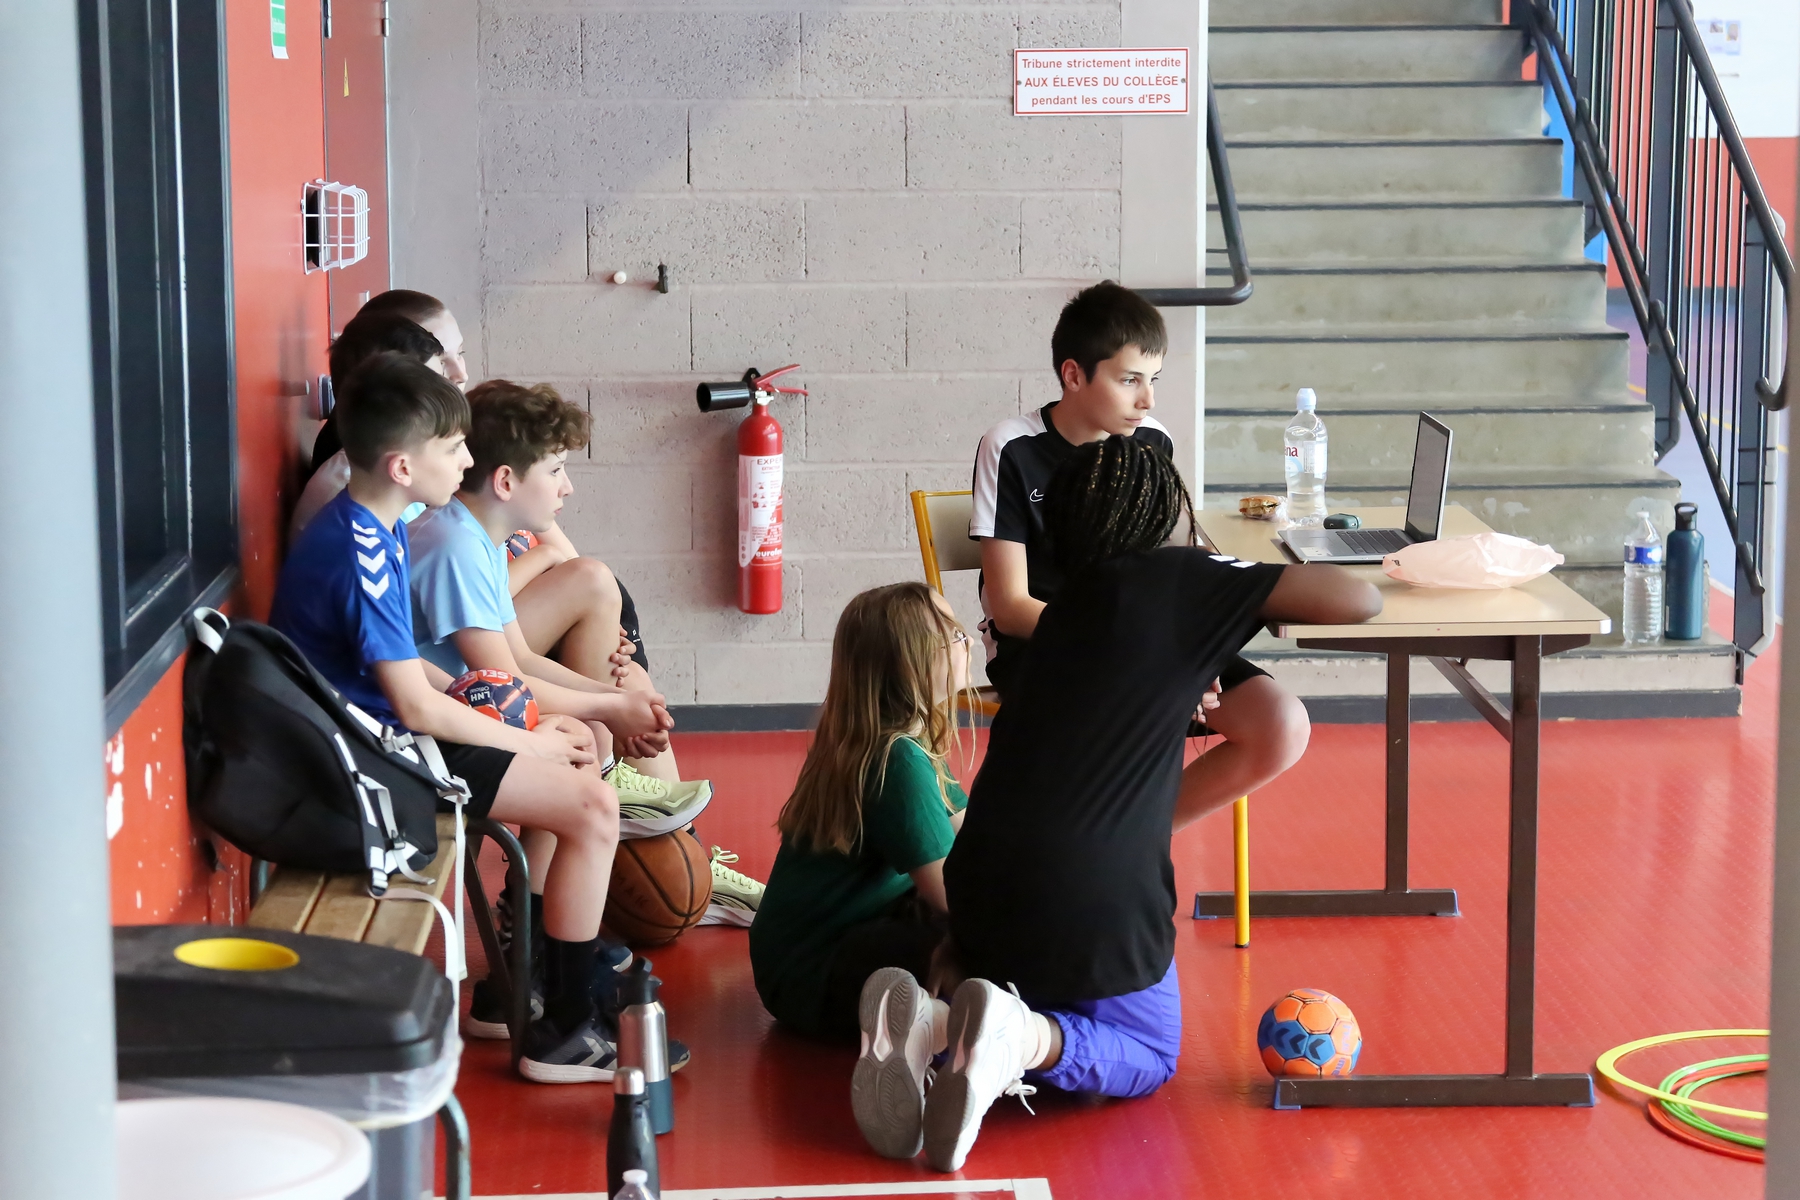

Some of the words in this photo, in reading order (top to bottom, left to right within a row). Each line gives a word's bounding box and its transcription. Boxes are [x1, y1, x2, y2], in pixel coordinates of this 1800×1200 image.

[1022, 58, 1062, 68] Tribune
[1067, 58, 1131, 68] strictement
[1135, 57, 1181, 68] interdite
[1024, 77, 1048, 87] AUX
[1053, 75, 1098, 87] ÉLEVES
[1103, 76, 1119, 87] DU
[1123, 74, 1178, 87] COLLÈGE
[1032, 95, 1077, 107] pendant
[1081, 95, 1097, 105] les
[1102, 96, 1134, 105] cours
[1138, 94, 1171, 105] d'EPS
[471, 691, 490, 701] LNH
